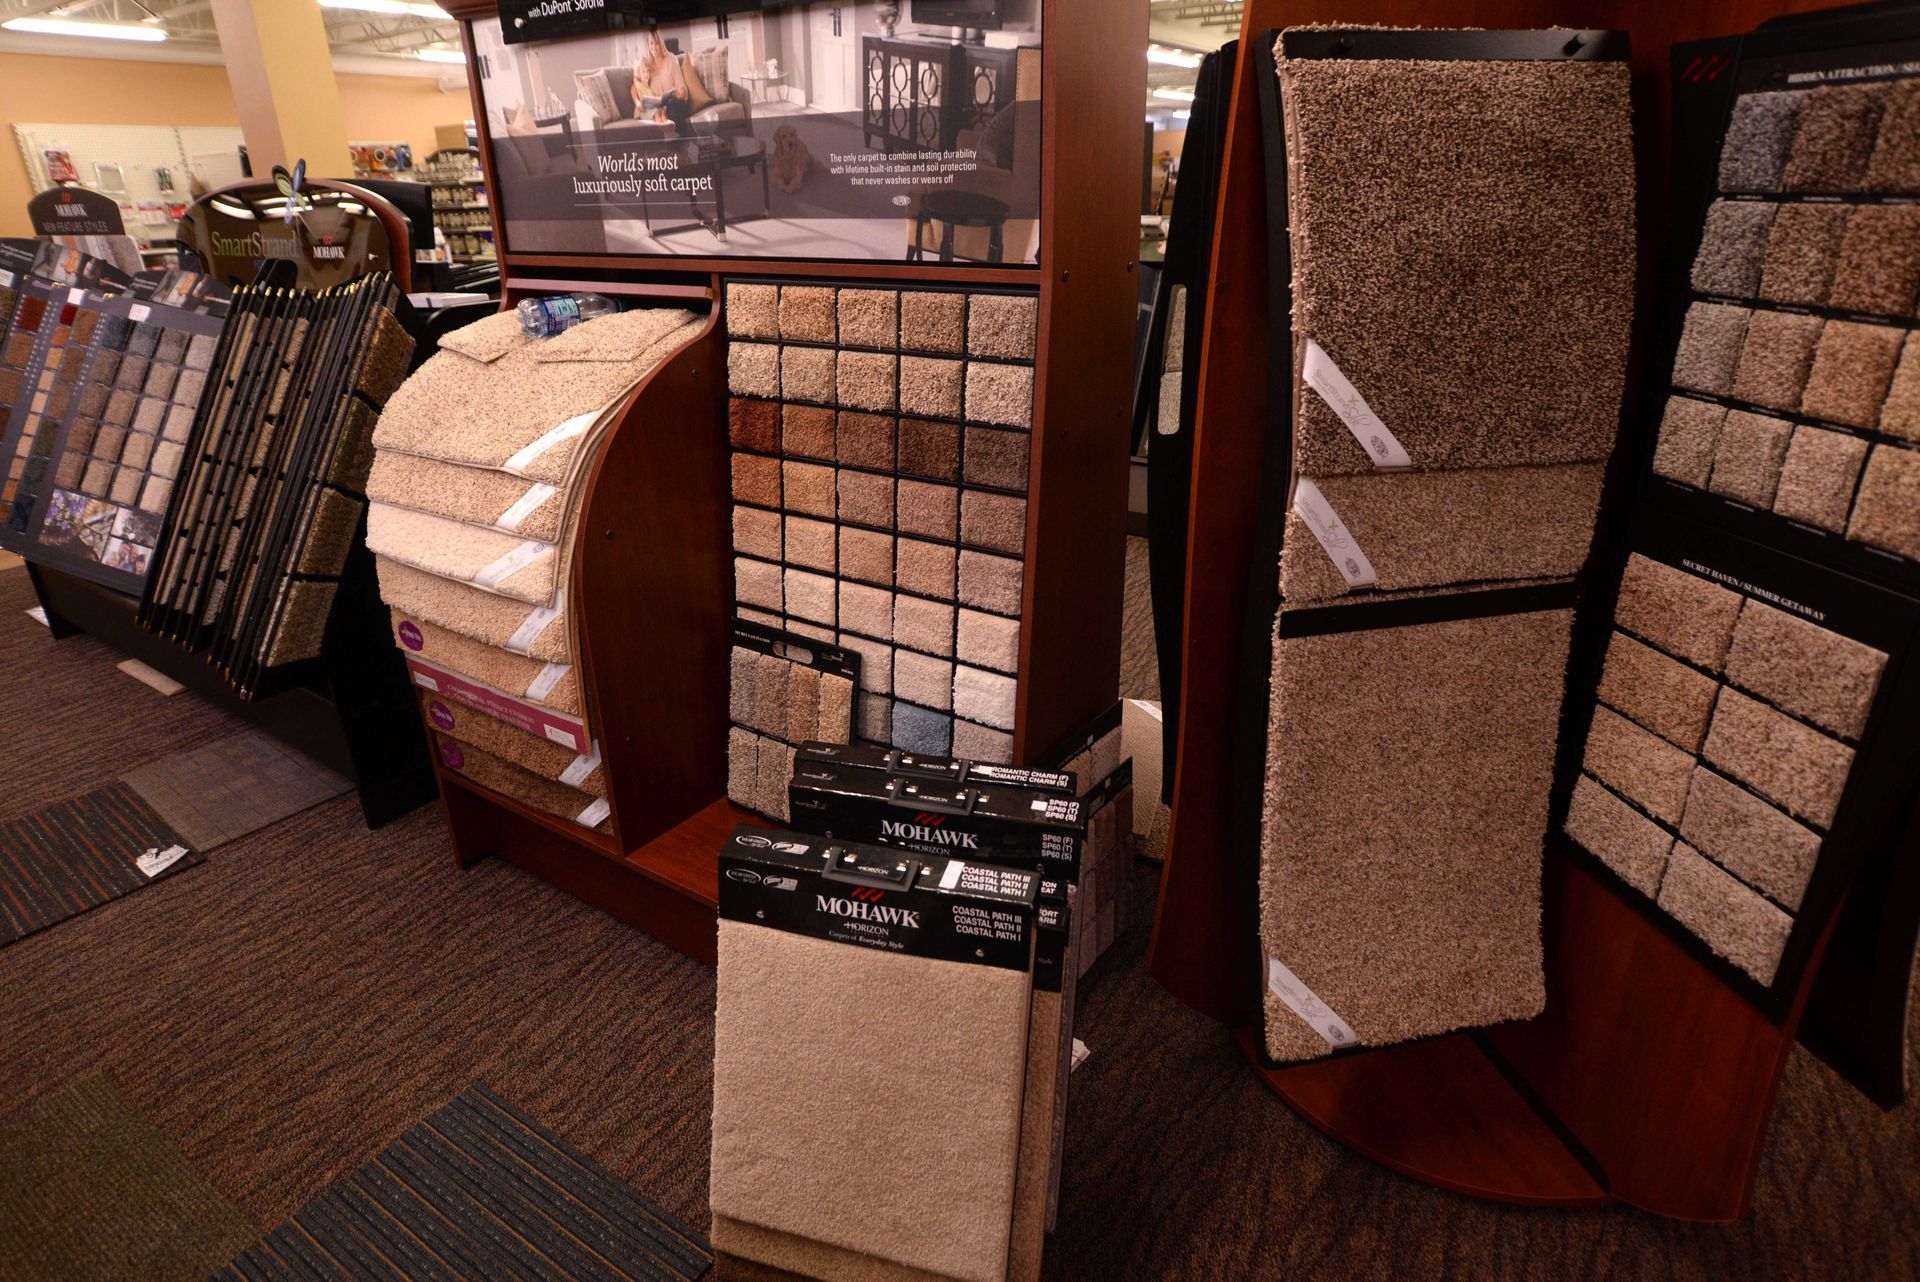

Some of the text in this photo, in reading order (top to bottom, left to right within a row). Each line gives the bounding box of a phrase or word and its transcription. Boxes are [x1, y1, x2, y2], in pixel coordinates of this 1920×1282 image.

[528, 6, 541, 18] with
[541, 0, 572, 16] DuPont
[598, 152, 678, 173] World's most
[830, 148, 977, 164] The only carpet to combine lasting durability
[830, 161, 977, 174] with lifetime built-in stain and soil protection
[573, 173, 712, 197] luxuriously soft carpet
[851, 174, 954, 185] that never washes or wears off
[42, 220, 109, 232] NEW FEATURE STYLES
[212, 230, 297, 258] SmartStrand
[313, 245, 346, 259] MOHAWK
[1682, 558, 1712, 576] SECRET
[1712, 570, 1739, 586] HAVEN
[1743, 583, 1780, 602] SUMMER
[1780, 597, 1826, 621] GETAWAY
[990, 772, 1028, 782] ROMANTIC
[1028, 776, 1056, 785] CHARM
[993, 766, 1030, 777] ROMANTIC
[1030, 771, 1058, 780] CHARM
[881, 820, 977, 849] MOHAWK
[1042, 833, 1073, 846] SP60 (F)
[907, 844, 951, 856] HORIZON
[1041, 849, 1072, 862] SP60 (S)
[1042, 841, 1073, 854] SP60 (T)
[961, 873, 998, 885] COASTAL
[1000, 879, 1021, 890] PATH
[962, 866, 1031, 883] COASTAL PATH III
[961, 881, 998, 893] COASTAL
[1000, 886, 1021, 897] PATH
[816, 894, 919, 928] MOHAWK
[952, 905, 1022, 924] COASTAL PATH III
[843, 921, 889, 936] HORIZON
[954, 915, 992, 929] COASTAL
[993, 921, 1015, 932] PATH
[828, 930, 850, 941] Carpets
[858, 935, 887, 947] Everyday
[888, 940, 904, 949] Style
[956, 925, 994, 938] COASTAL
[995, 930, 1017, 941] PATH
